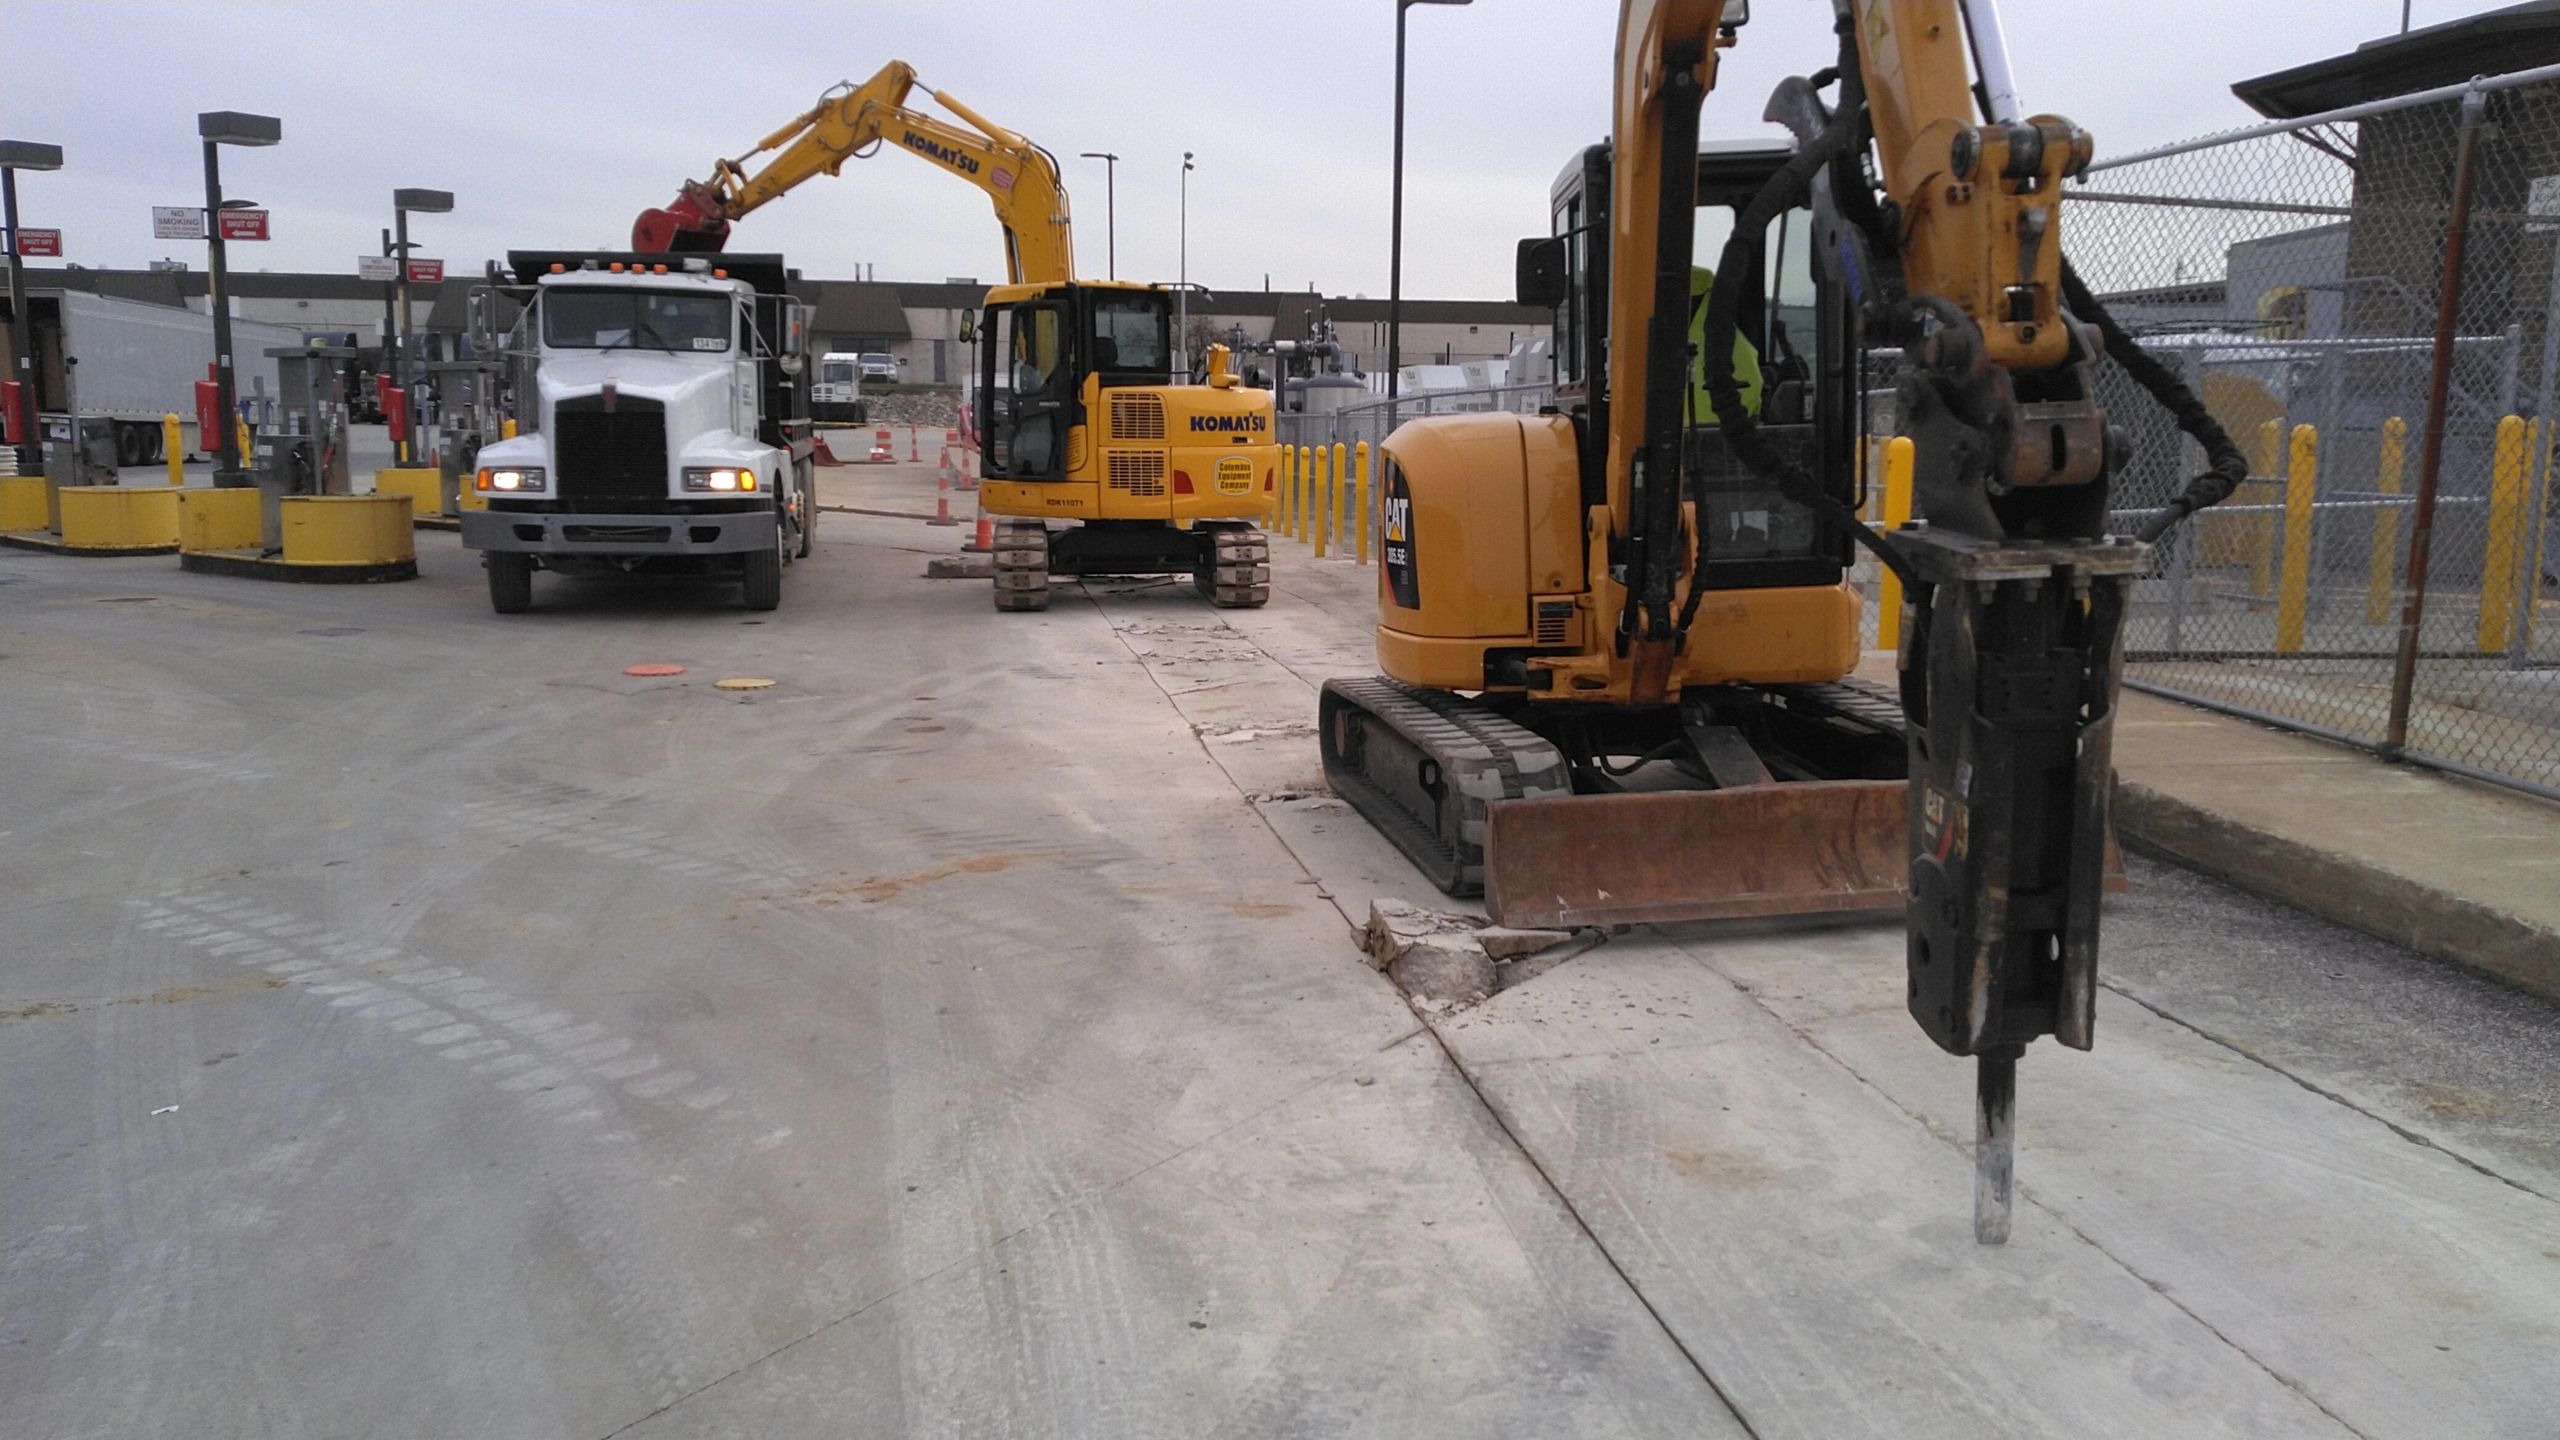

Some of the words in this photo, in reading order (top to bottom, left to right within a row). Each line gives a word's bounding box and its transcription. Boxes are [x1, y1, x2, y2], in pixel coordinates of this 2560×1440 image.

[903, 130, 979, 174] KOMATSU
[170, 209, 184, 217] NO
[221, 212, 264, 220] EMERGENCY
[157, 217, 200, 226] SMOKING
[226, 220, 245, 228] SHUT
[246, 220, 260, 228] OFF
[18, 230, 57, 238] EMERGENCY
[1190, 411, 1266, 432] KOMATSU
[1219, 462, 1251, 472] Columbus
[1218, 471, 1252, 481] Equipment
[1220, 480, 1250, 490] Company
[1385, 497, 1408, 541] CAT
